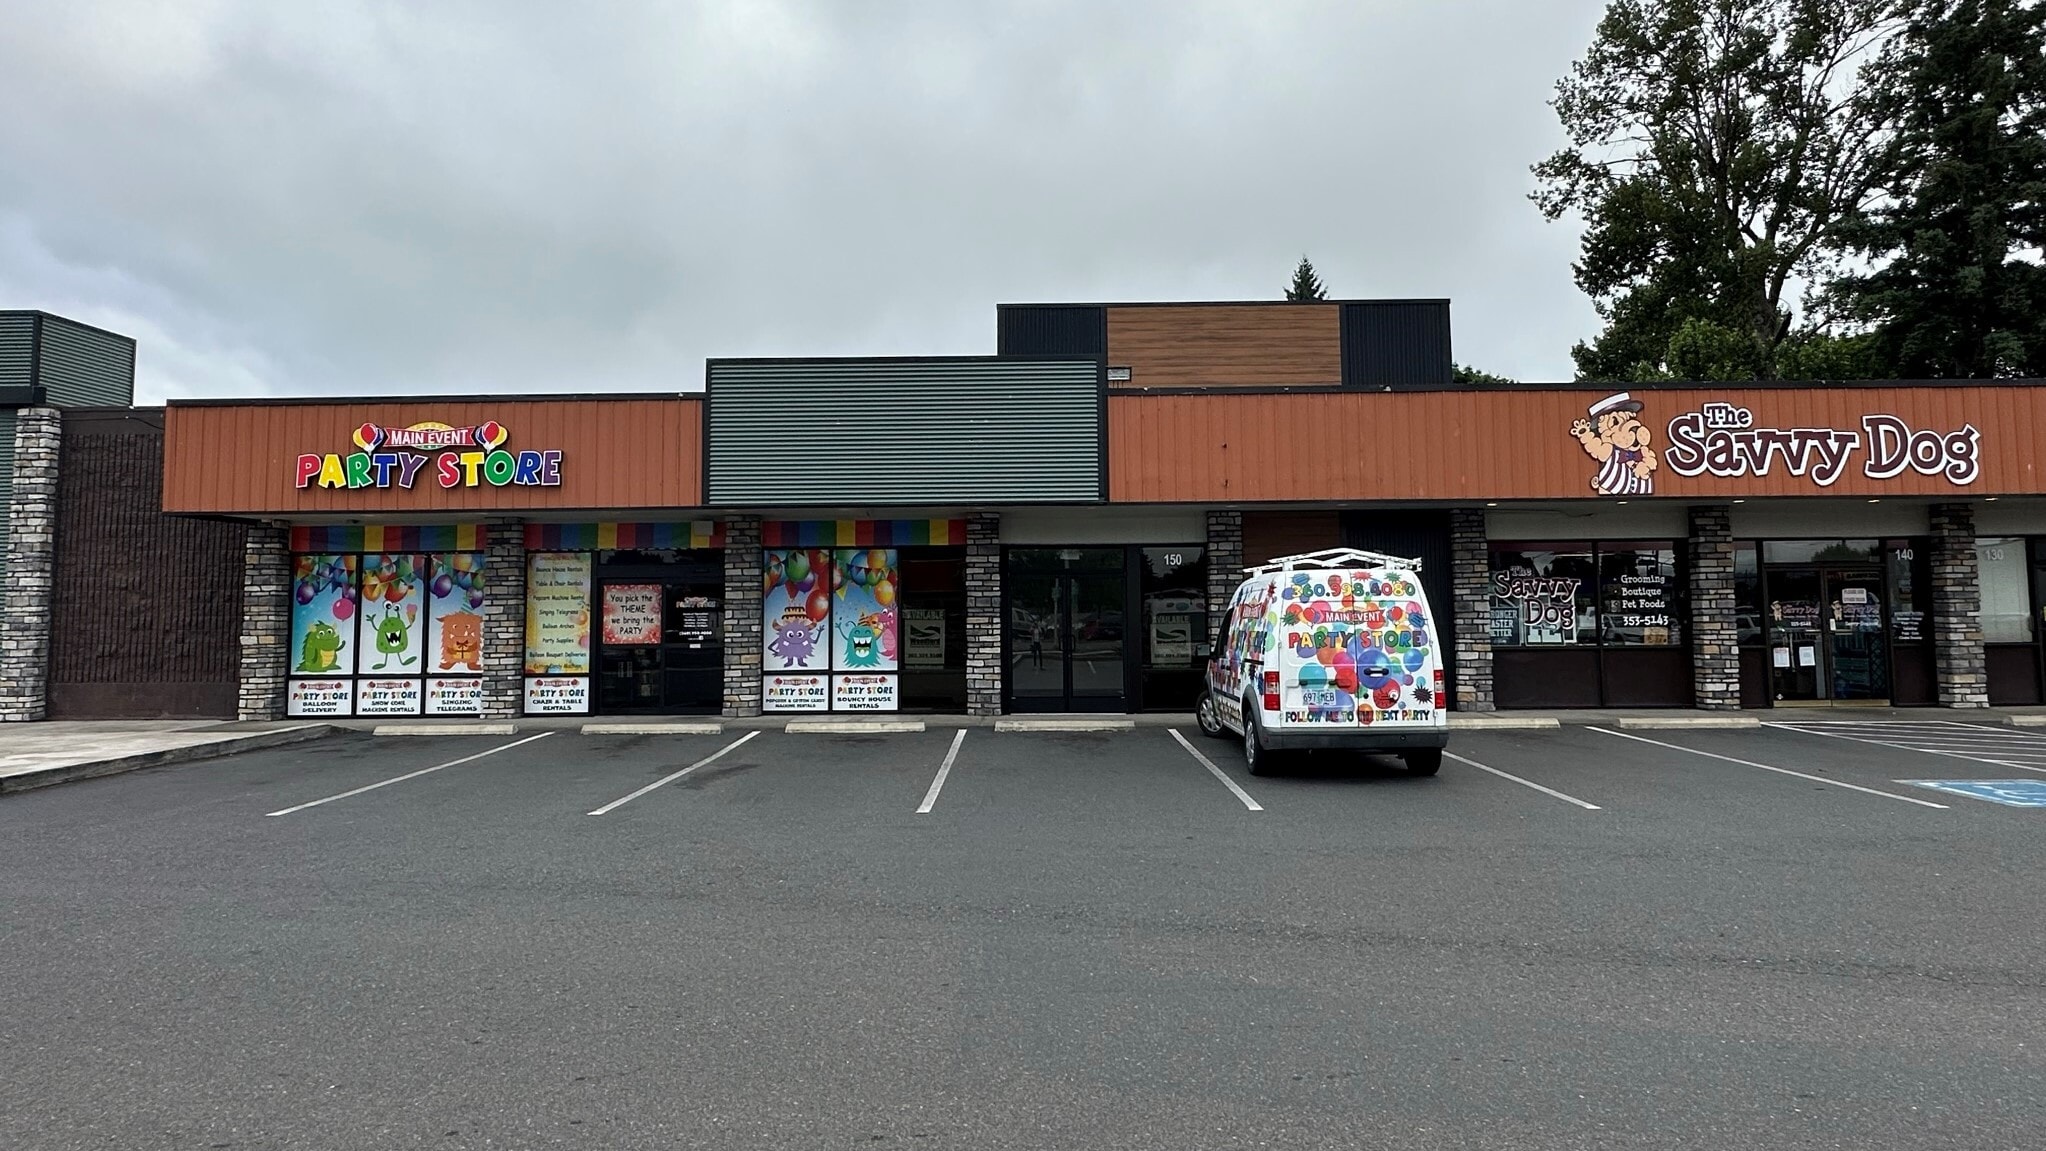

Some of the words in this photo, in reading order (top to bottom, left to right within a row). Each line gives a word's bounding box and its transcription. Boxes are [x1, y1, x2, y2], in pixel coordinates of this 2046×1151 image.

[1704, 402, 1752, 428] The
[391, 430, 424, 445] MAIN
[428, 428, 468, 445] EVENT
[1665, 414, 1859, 486] Savvy
[1862, 414, 1981, 486] Dog
[296, 452, 429, 489] PARTY
[437, 450, 562, 488] STORE
[1164, 554, 1182, 566] 150
[1896, 549, 1913, 560] 140
[1985, 549, 2004, 560] 130
[1510, 565, 1532, 576] The
[1620, 574, 1666, 584] Grooming
[1494, 570, 1582, 603] Savvy
[1622, 587, 1662, 597] Boutique
[625, 594, 639, 603] pick
[1622, 600, 1637, 608] Pet
[1639, 599, 1666, 608] Foods
[620, 605, 646, 613] THEME
[1491, 610, 1517, 619] RONGER
[1524, 598, 1576, 630] Dog
[907, 610, 944, 620] AVAILABLE
[1326, 612, 1349, 622] MAIN
[1352, 611, 1381, 621] EVENT
[1623, 614, 1669, 626] 353-5143
[623, 616, 640, 626] bring
[1491, 620, 1513, 628] ASTER
[1288, 631, 1353, 649] PARTY
[1359, 630, 1422, 648] STORE
[530, 689, 556, 697] PARTY
[1303, 693, 1316, 702] 697
[1285, 711, 1322, 722] FOLLOW
[1325, 711, 1340, 722] ME
[1342, 711, 1354, 722] TO
[1375, 710, 1399, 721] NEXT
[1402, 710, 1430, 721] PARTY
